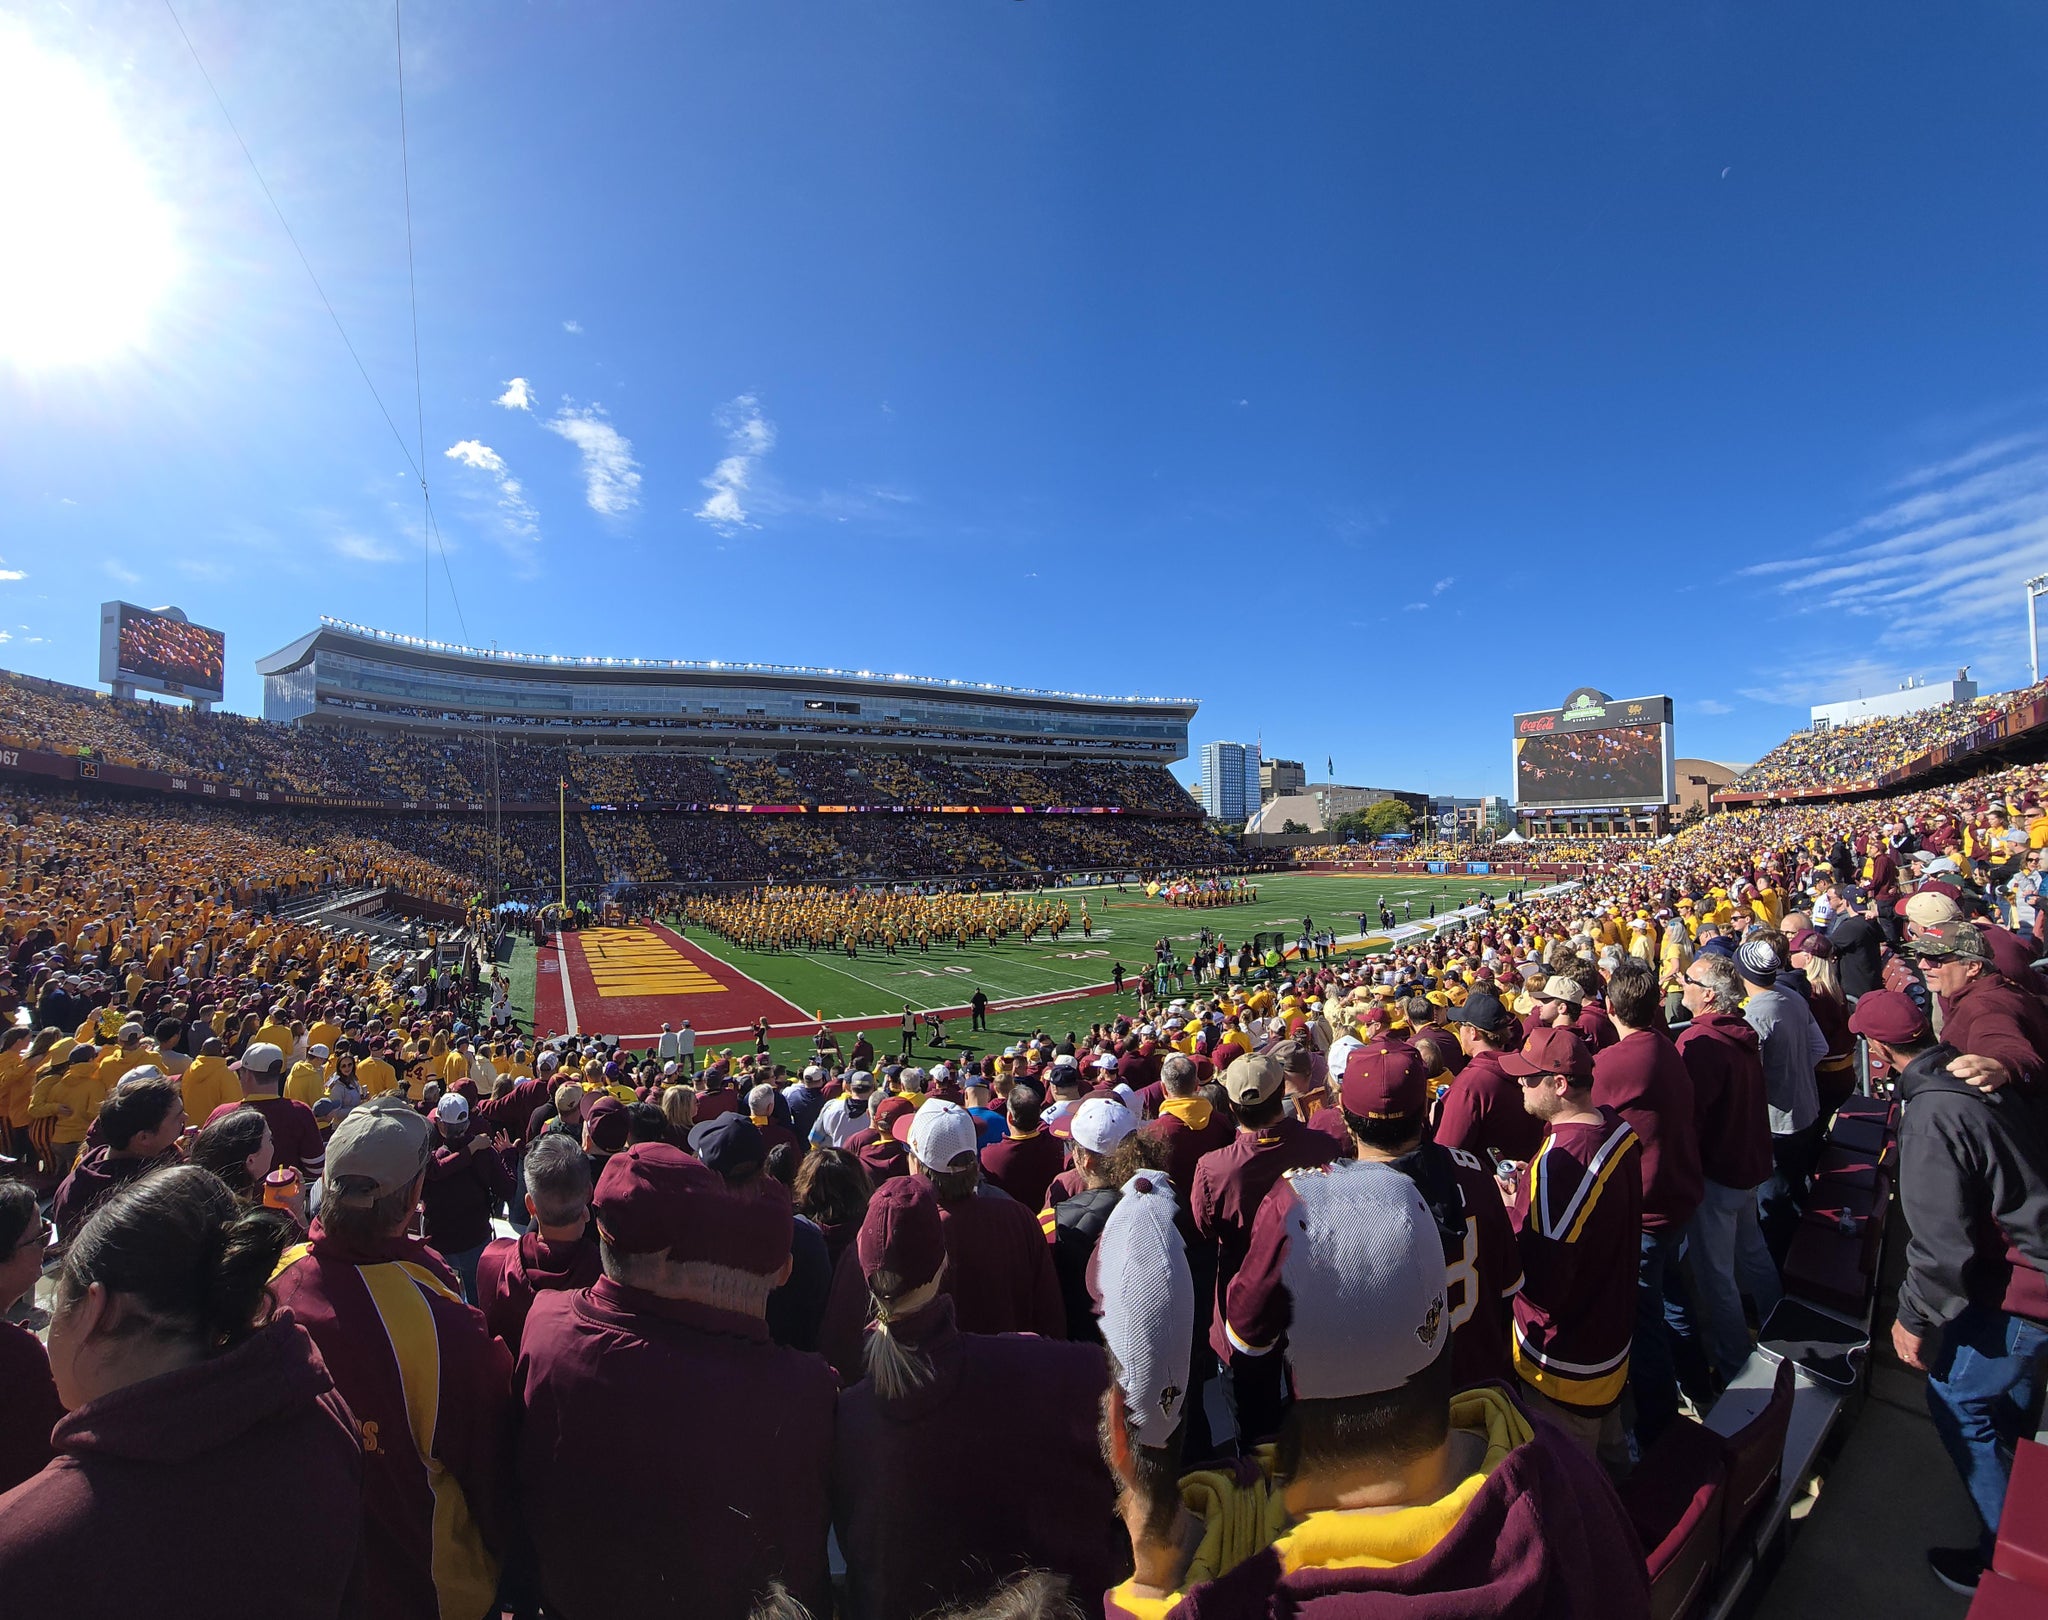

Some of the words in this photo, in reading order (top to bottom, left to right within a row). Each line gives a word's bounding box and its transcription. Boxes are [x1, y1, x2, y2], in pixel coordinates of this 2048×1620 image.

[0, 749, 19, 766] 67
[84, 763, 96, 776] 25
[172, 778, 187, 790] 1904
[203, 784, 216, 795] 1934
[285, 795, 318, 804] NATIONAL
[323, 798, 385, 807] CHAMPIONSHIPS
[402, 801, 418, 809] 1940
[1818, 905, 1827, 914] 10
